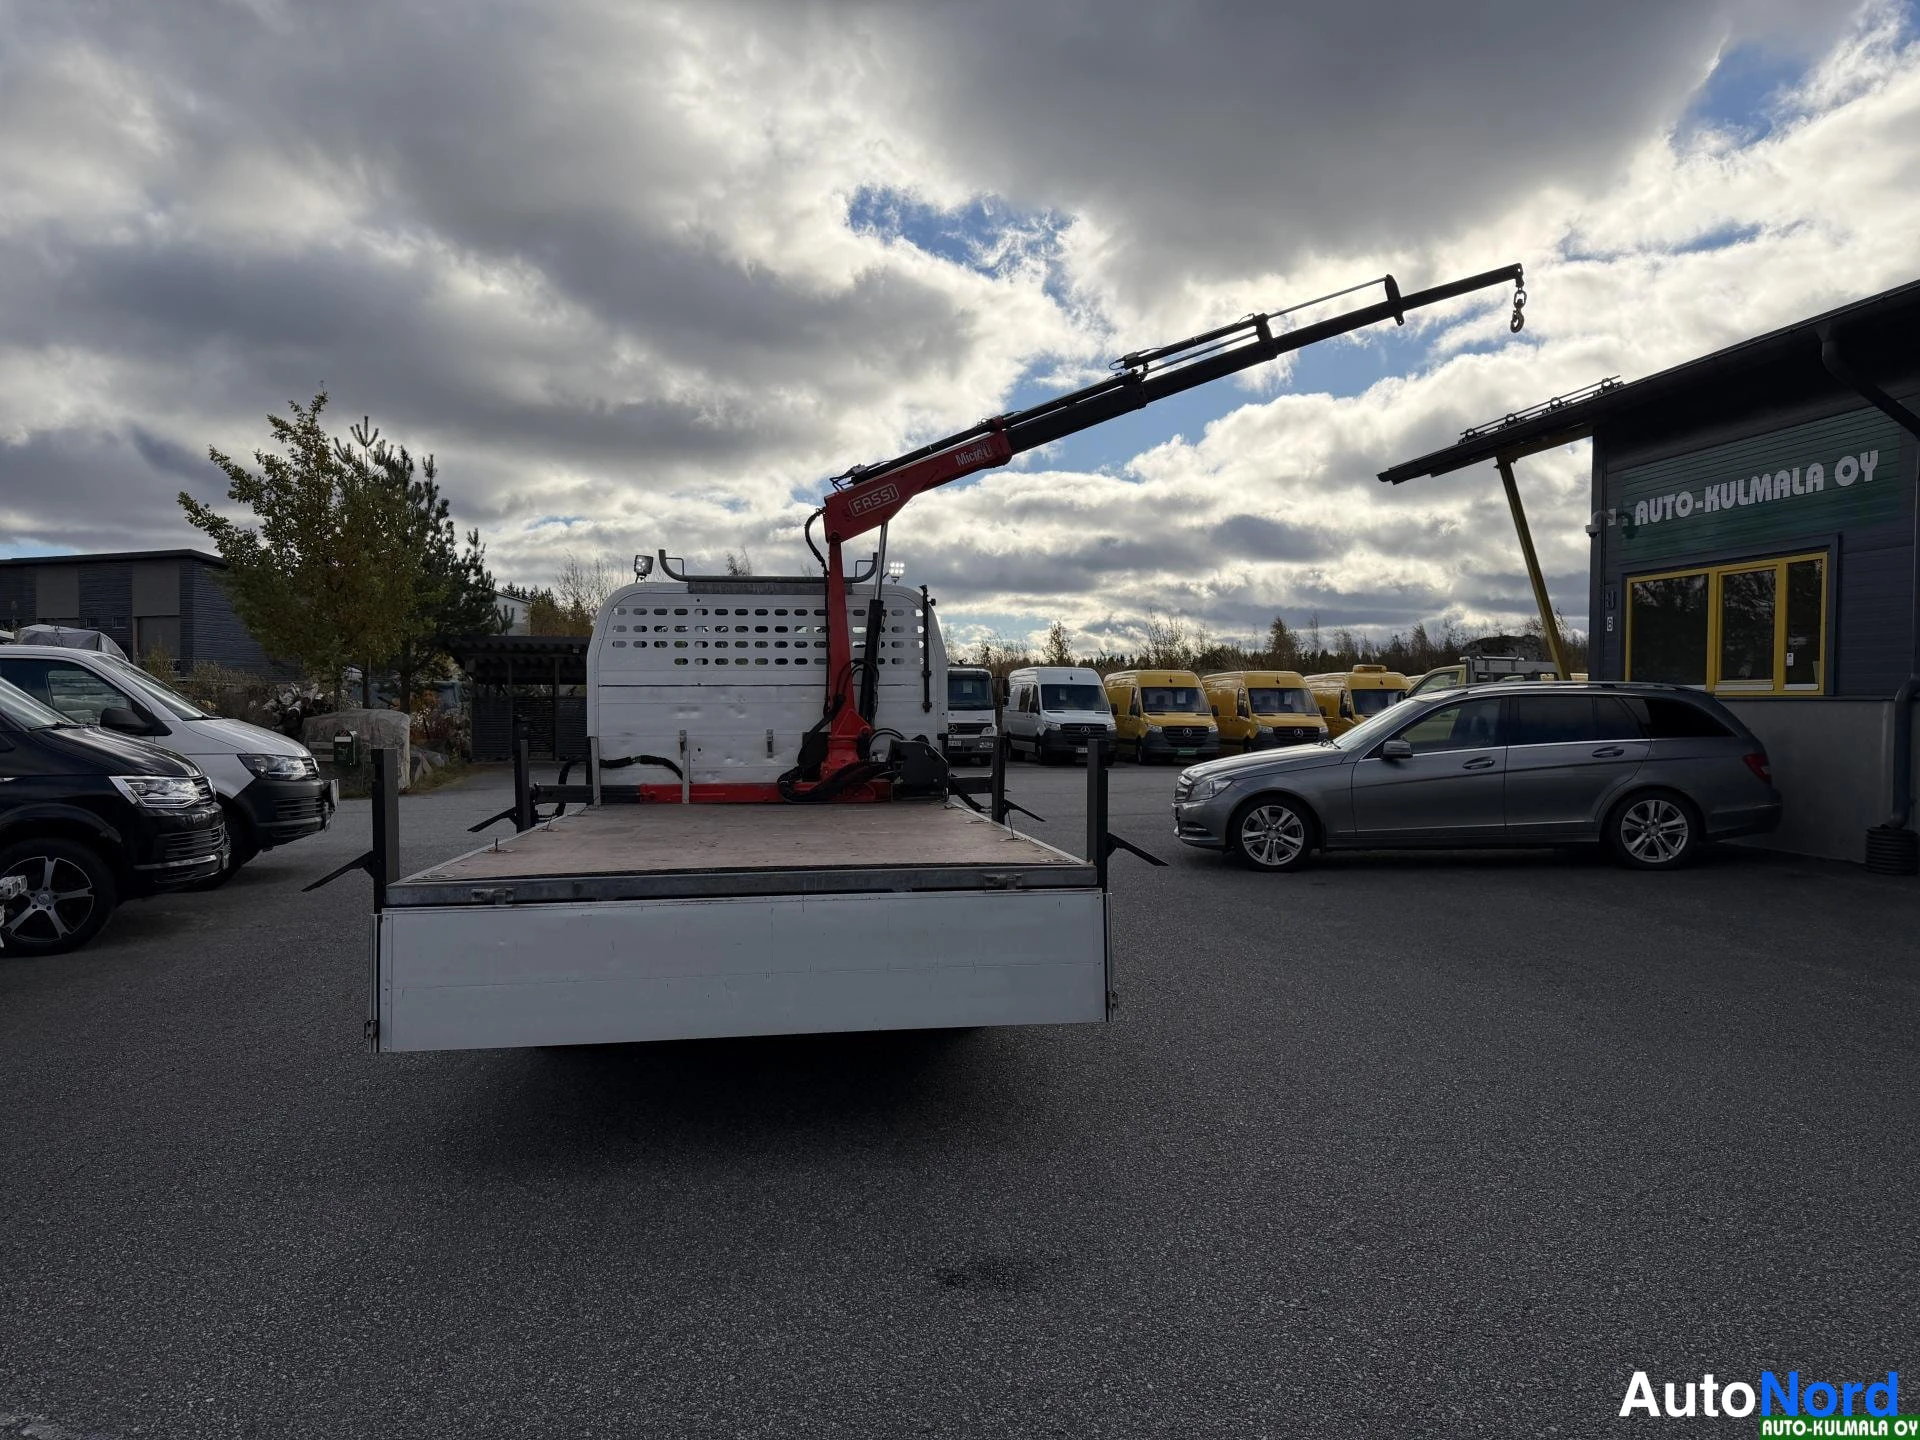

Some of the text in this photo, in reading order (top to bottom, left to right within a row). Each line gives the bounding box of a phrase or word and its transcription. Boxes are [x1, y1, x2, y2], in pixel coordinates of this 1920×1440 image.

[852, 486, 895, 513] FASSI
[1635, 450, 1879, 526] AUTO-KULMALA OY
